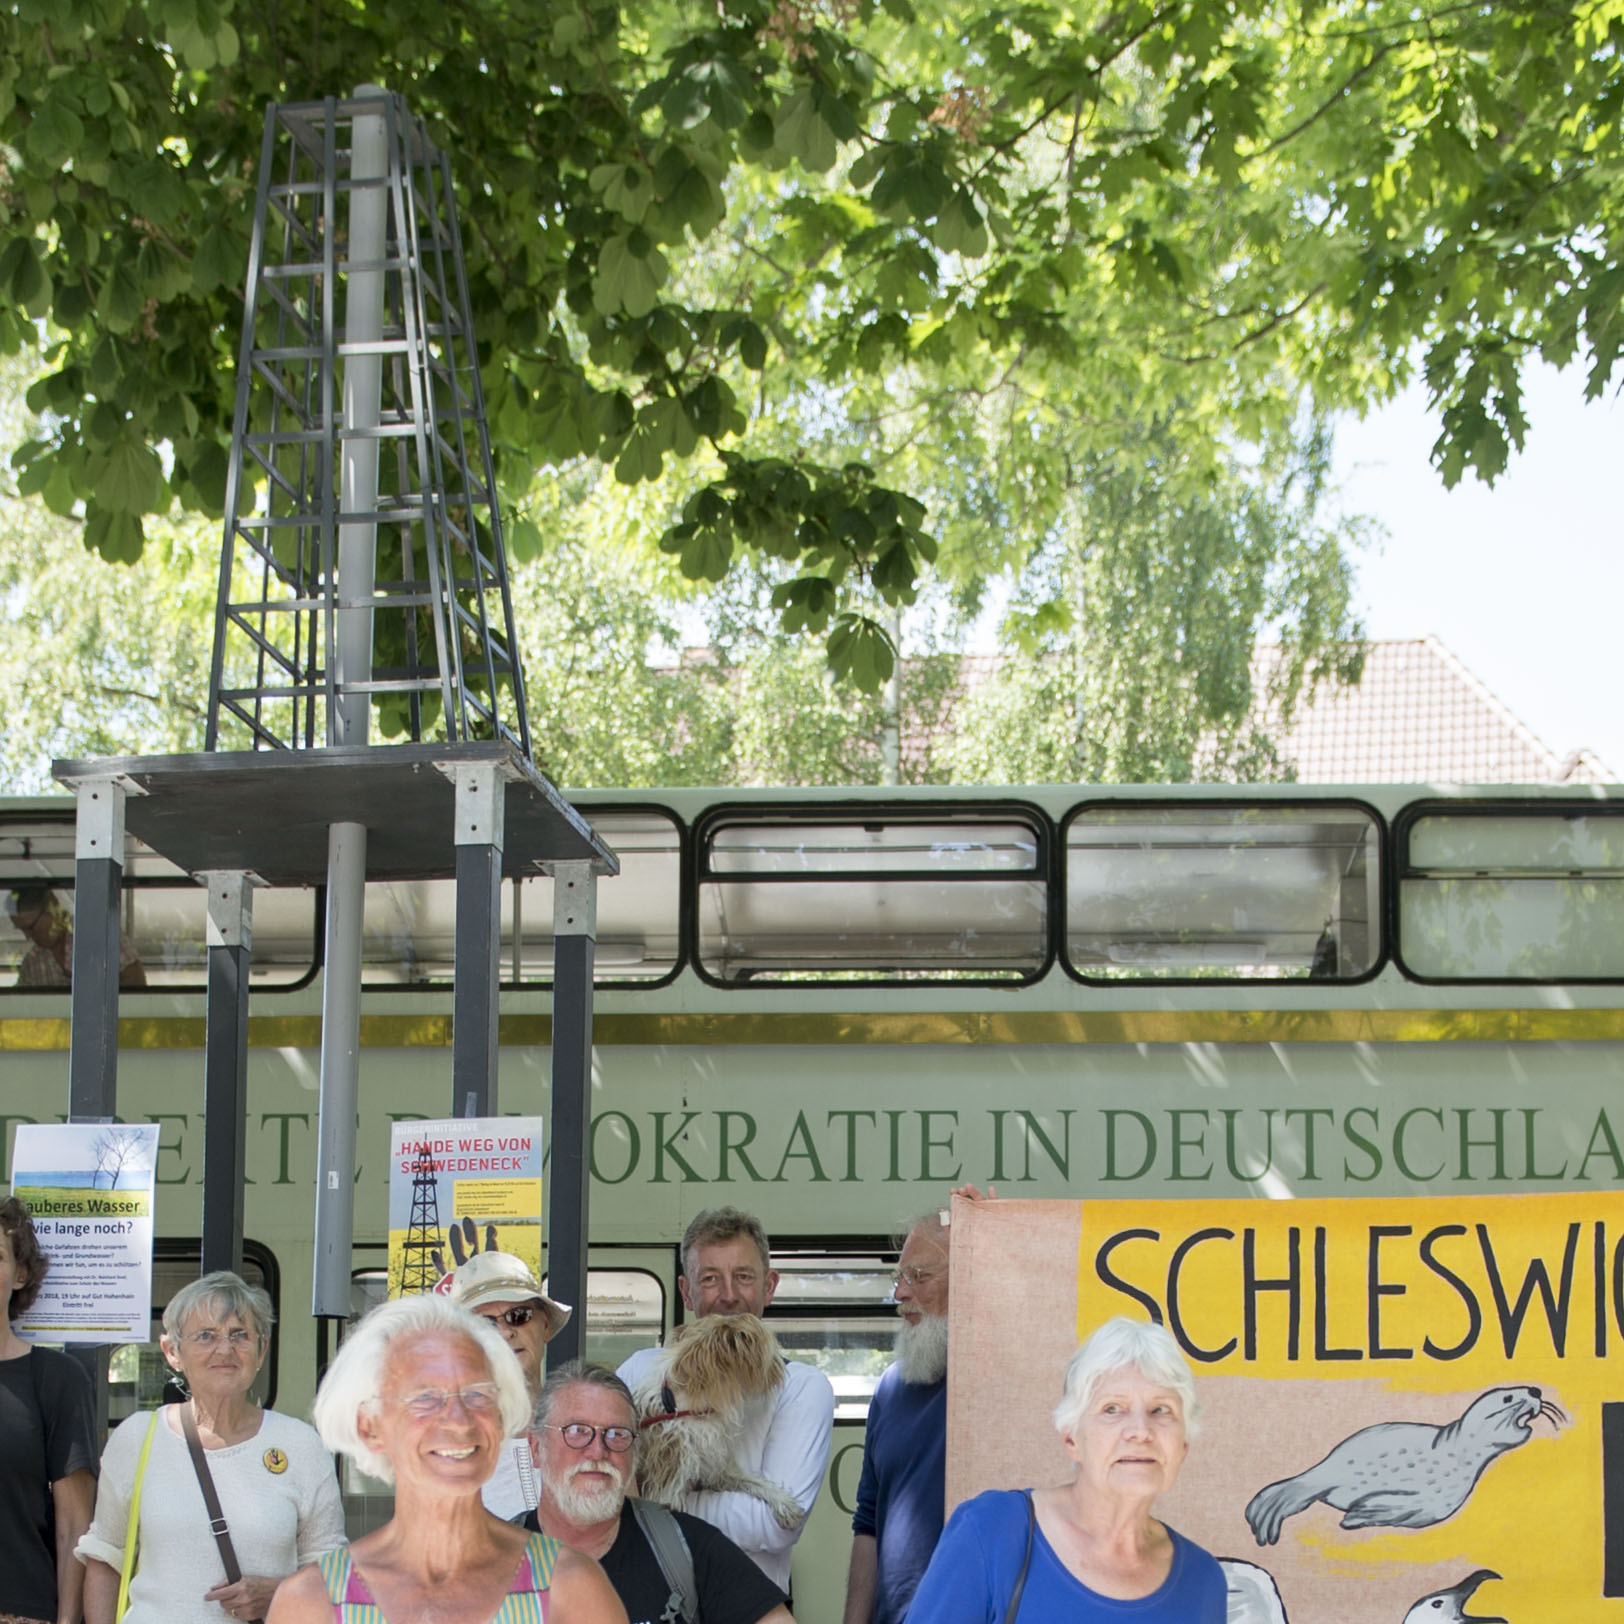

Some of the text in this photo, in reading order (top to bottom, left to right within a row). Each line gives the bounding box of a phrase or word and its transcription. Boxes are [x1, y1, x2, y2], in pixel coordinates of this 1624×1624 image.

[385, 1110, 962, 1184] OKRATIE
[986, 1109, 1079, 1183] IN
[459, 1138, 493, 1152] WEG
[498, 1137, 531, 1151] VON
[26, 1200, 140, 1213] auberes Wasser
[55, 1221, 90, 1237] lange
[94, 1220, 133, 1234] noch?
